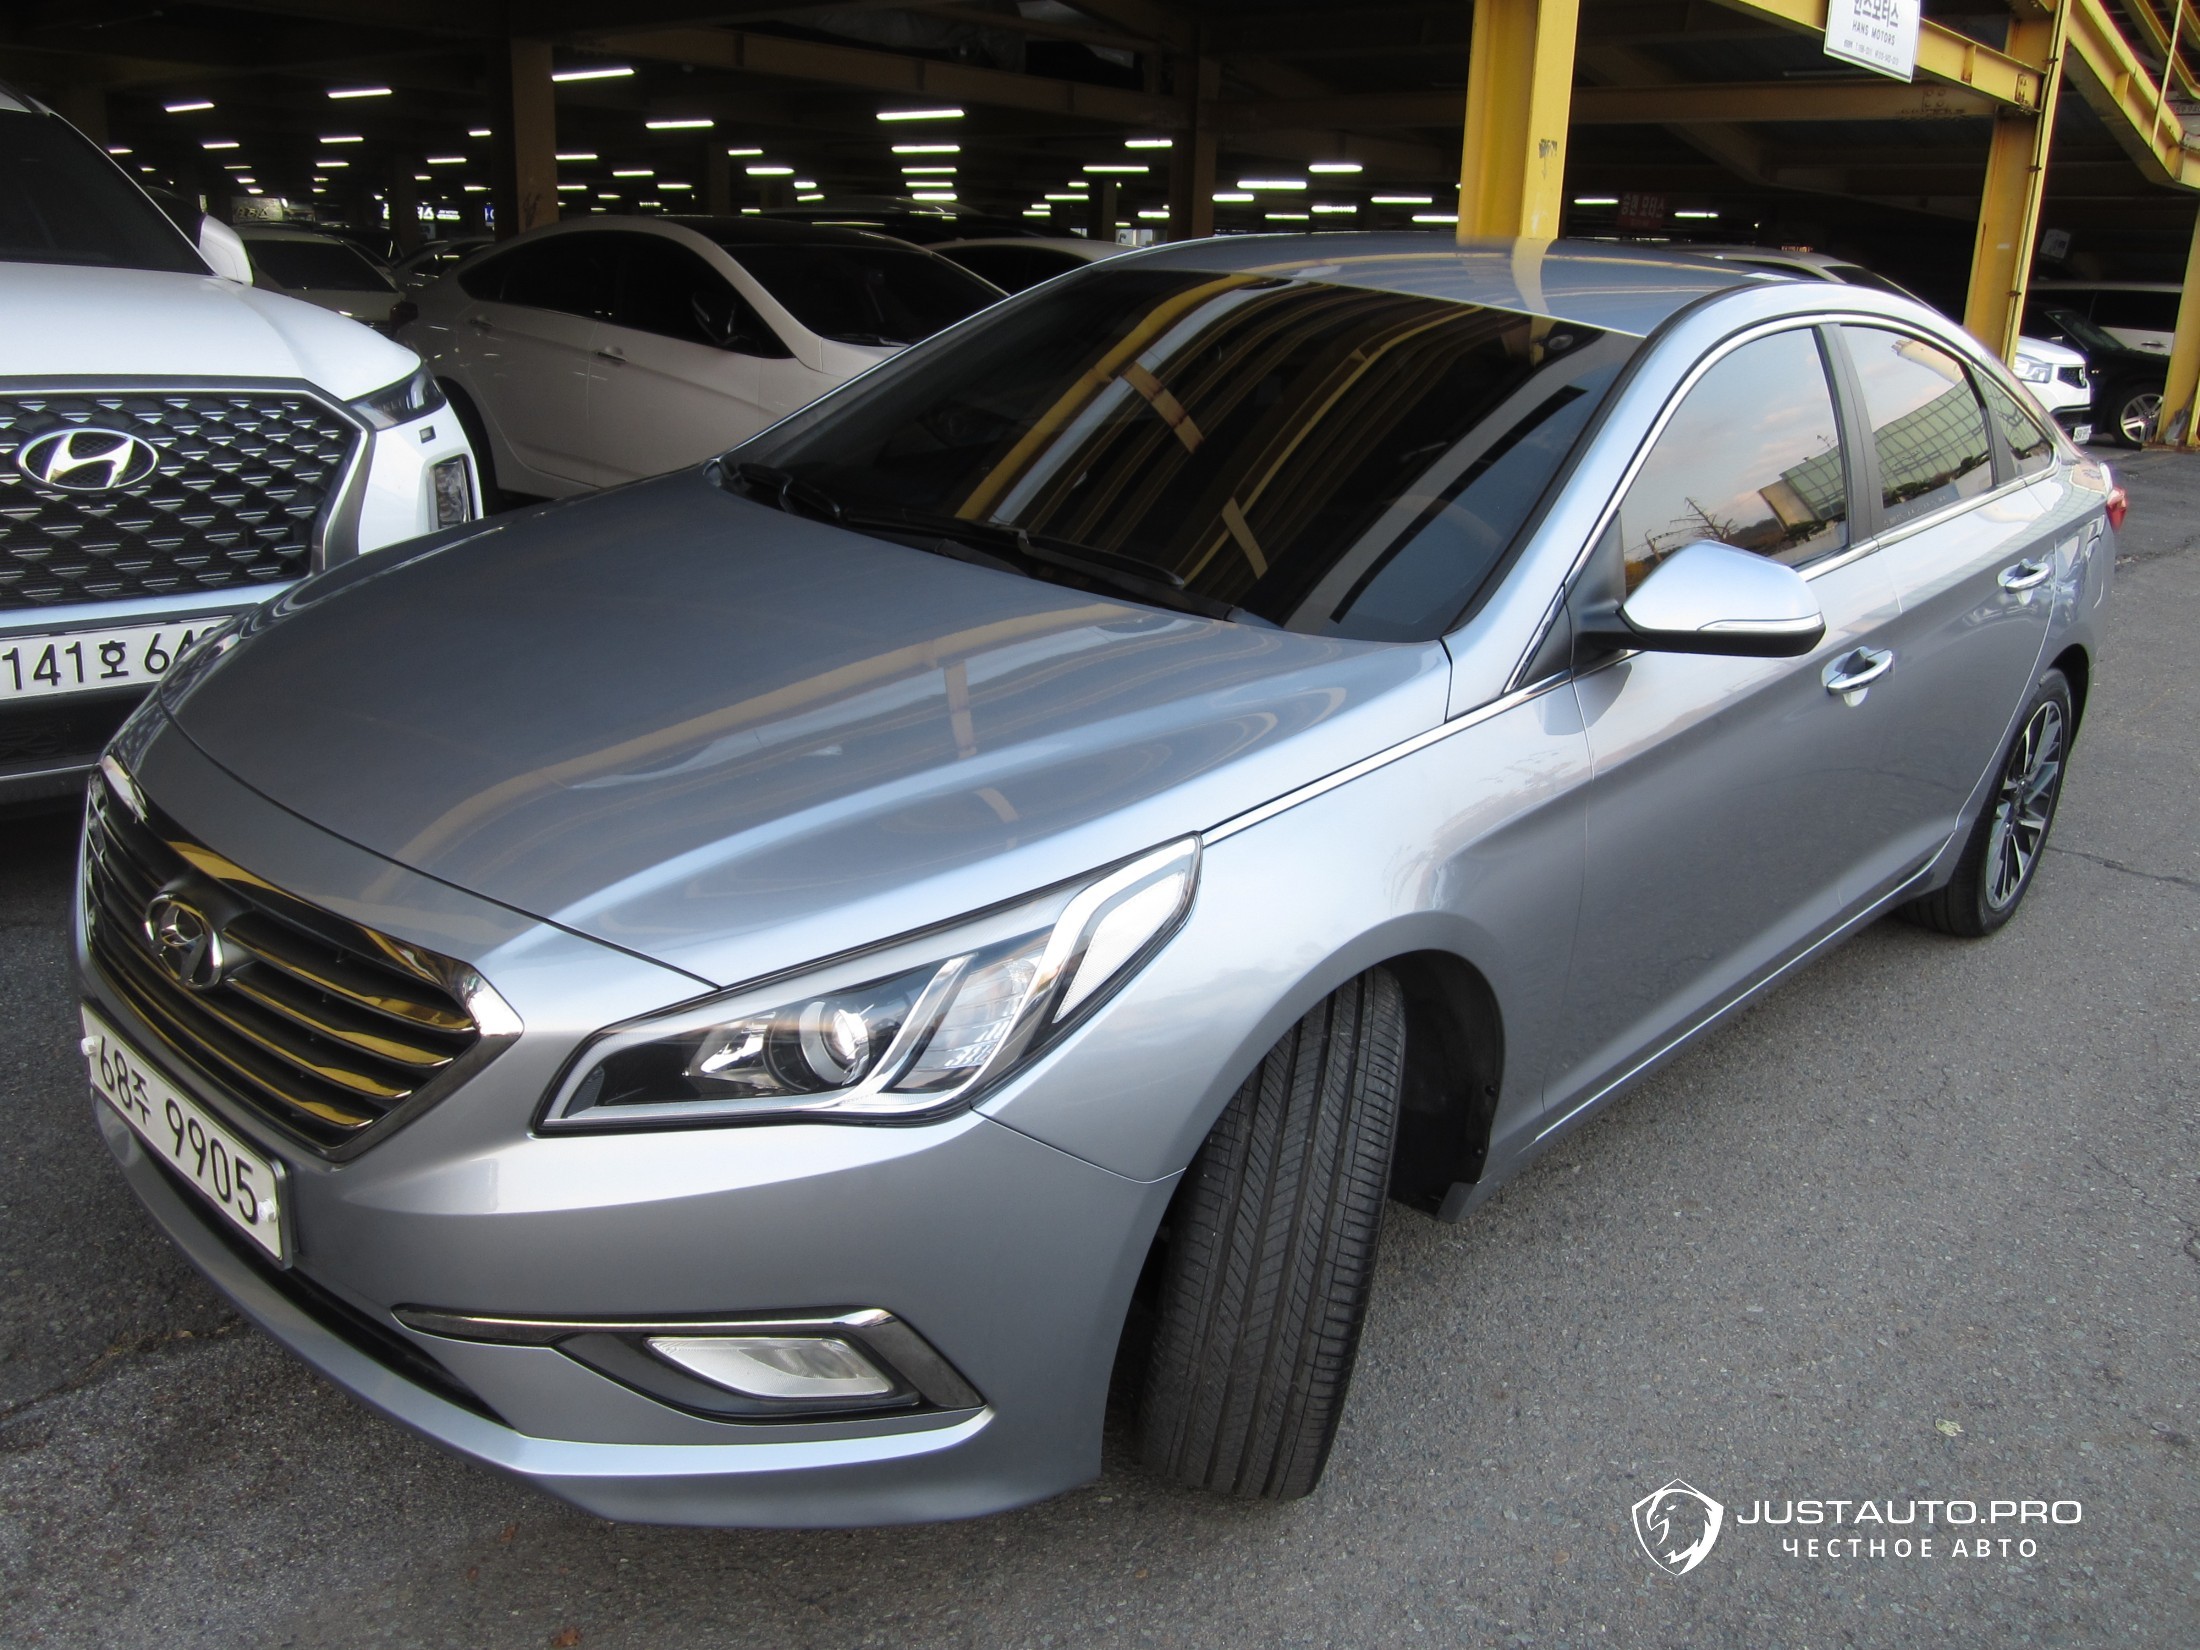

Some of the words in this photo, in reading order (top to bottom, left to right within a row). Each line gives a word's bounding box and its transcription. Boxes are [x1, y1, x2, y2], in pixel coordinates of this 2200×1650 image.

[1853, 20, 1869, 36] HANS
[1872, 27, 1896, 46] MOTORS
[100, 1035, 151, 1126] 68주
[165, 1097, 259, 1226] 9905
